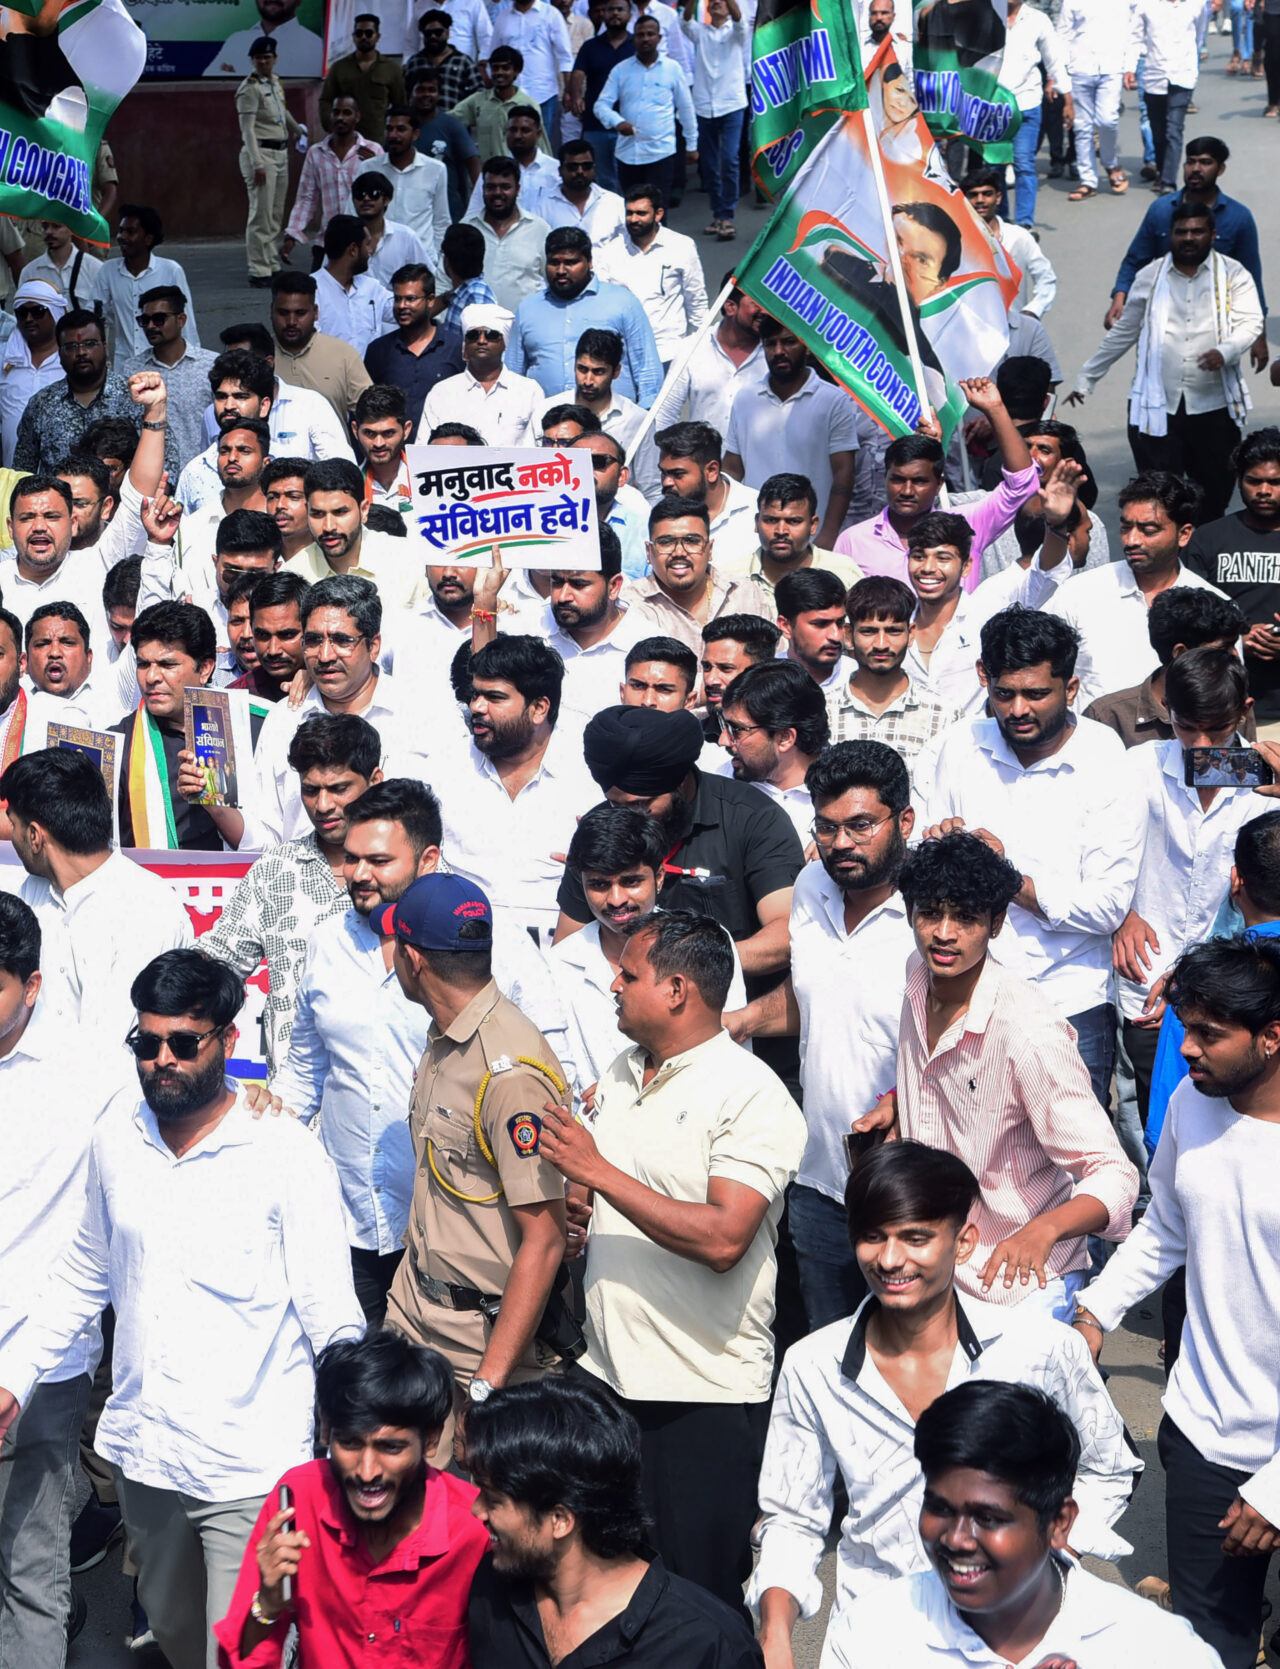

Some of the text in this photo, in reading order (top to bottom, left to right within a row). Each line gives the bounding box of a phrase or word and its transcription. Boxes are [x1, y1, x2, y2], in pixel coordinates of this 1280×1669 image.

[761, 255, 828, 326] INDIAN
[815, 303, 879, 372] YOUTH
[864, 350, 923, 434] CONGRE
[414, 452, 581, 501] मनुवाद नको,
[417, 493, 591, 549] संविधान हवे!
